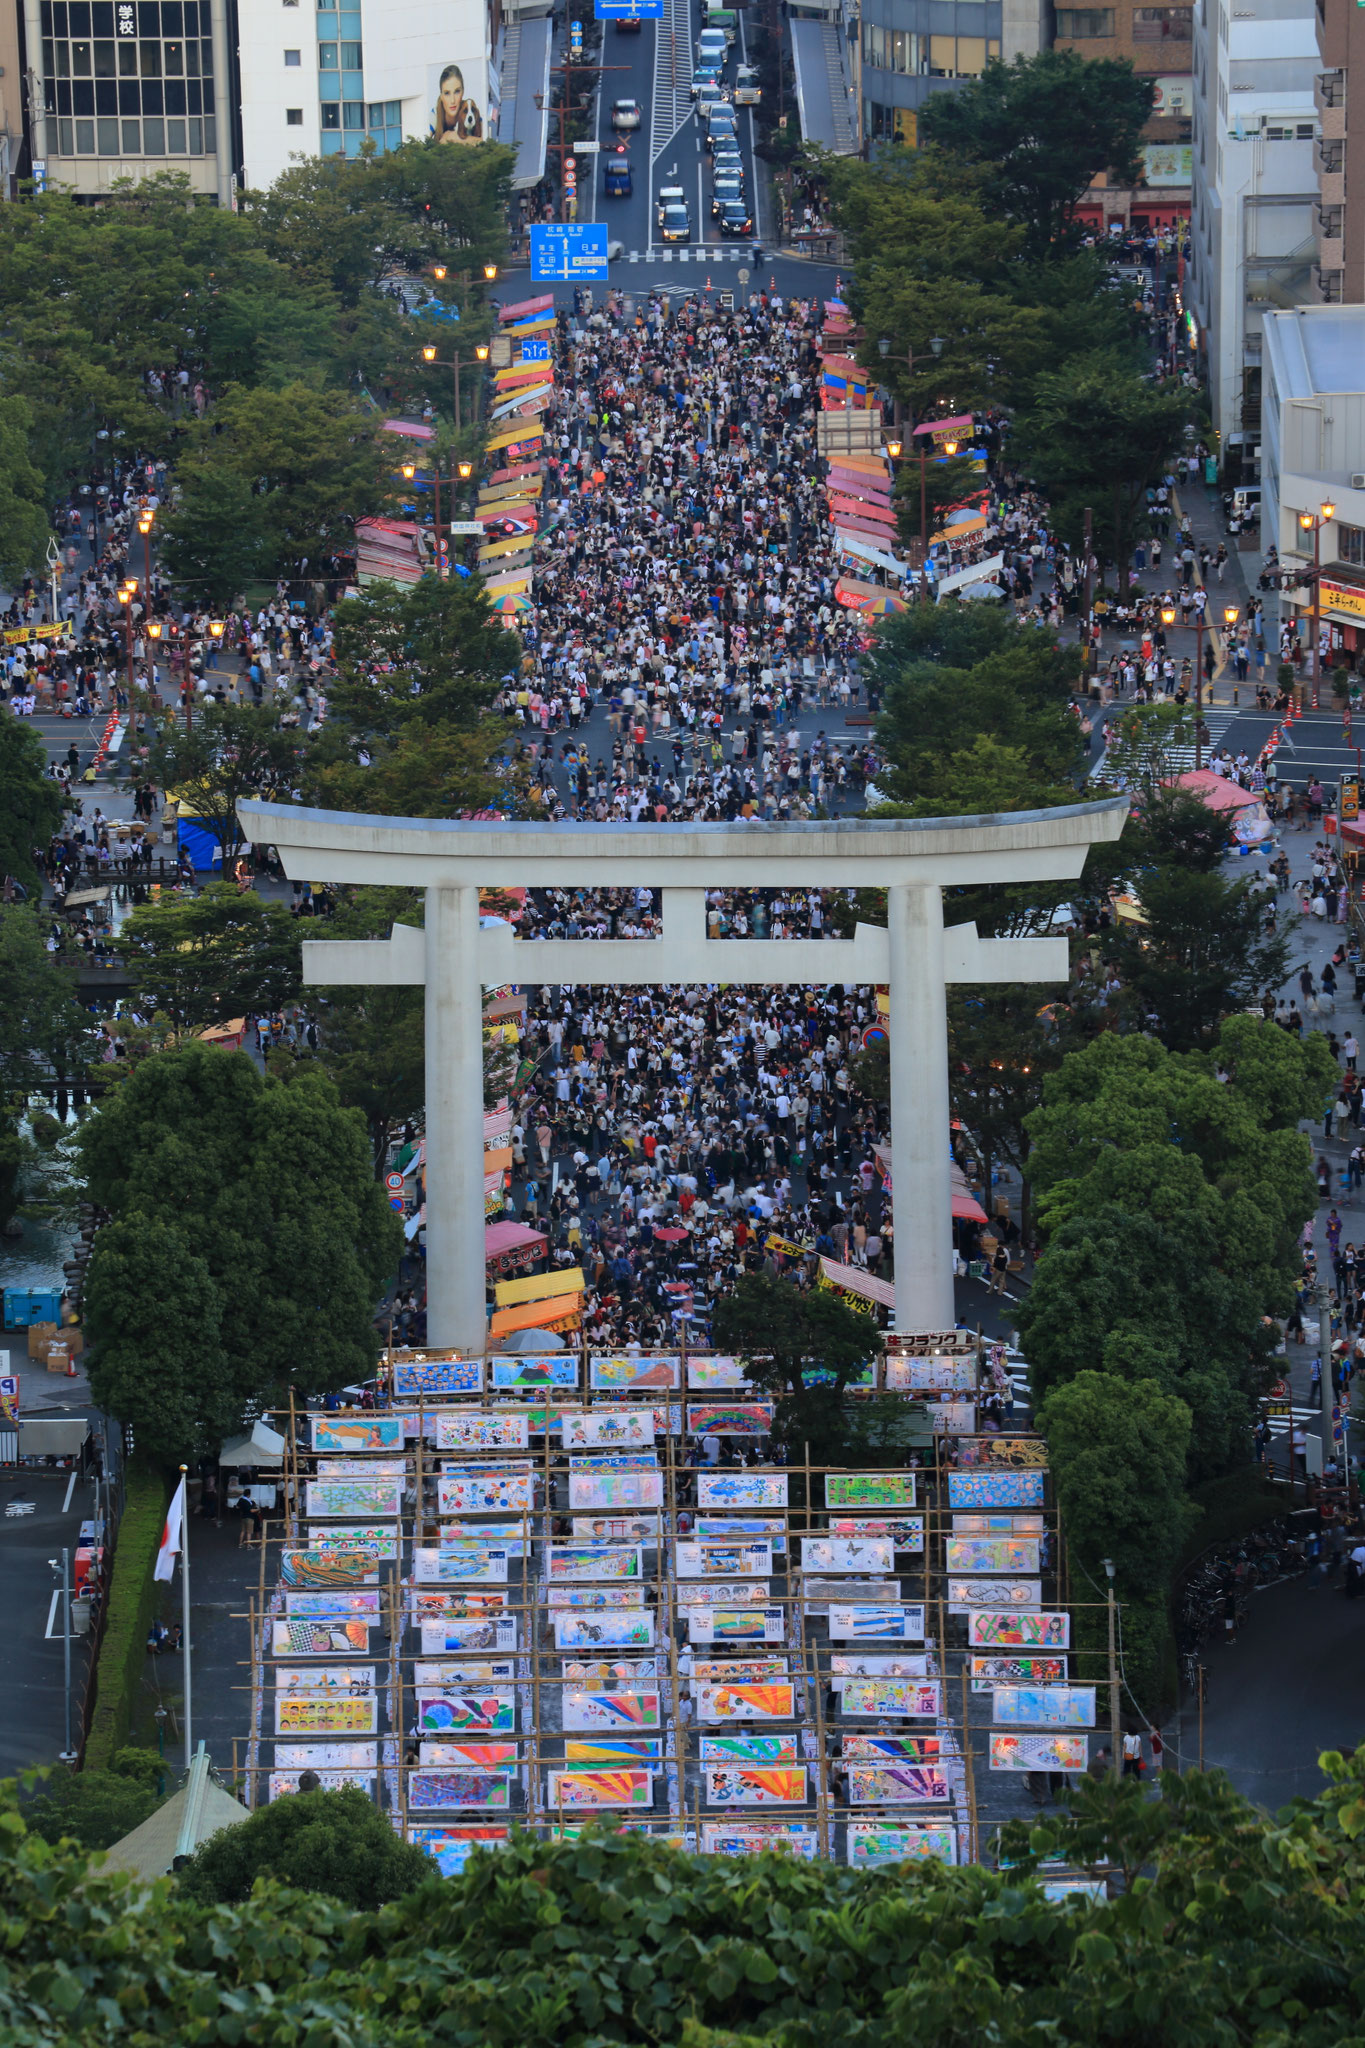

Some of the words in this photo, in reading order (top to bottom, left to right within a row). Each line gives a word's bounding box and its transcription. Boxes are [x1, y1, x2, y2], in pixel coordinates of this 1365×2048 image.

[118, 5, 135, 35] 学校
[1343, 776, 1352, 784] P
[390, 1176, 400, 1186] 40
[789, 1786, 804, 1800] 校
